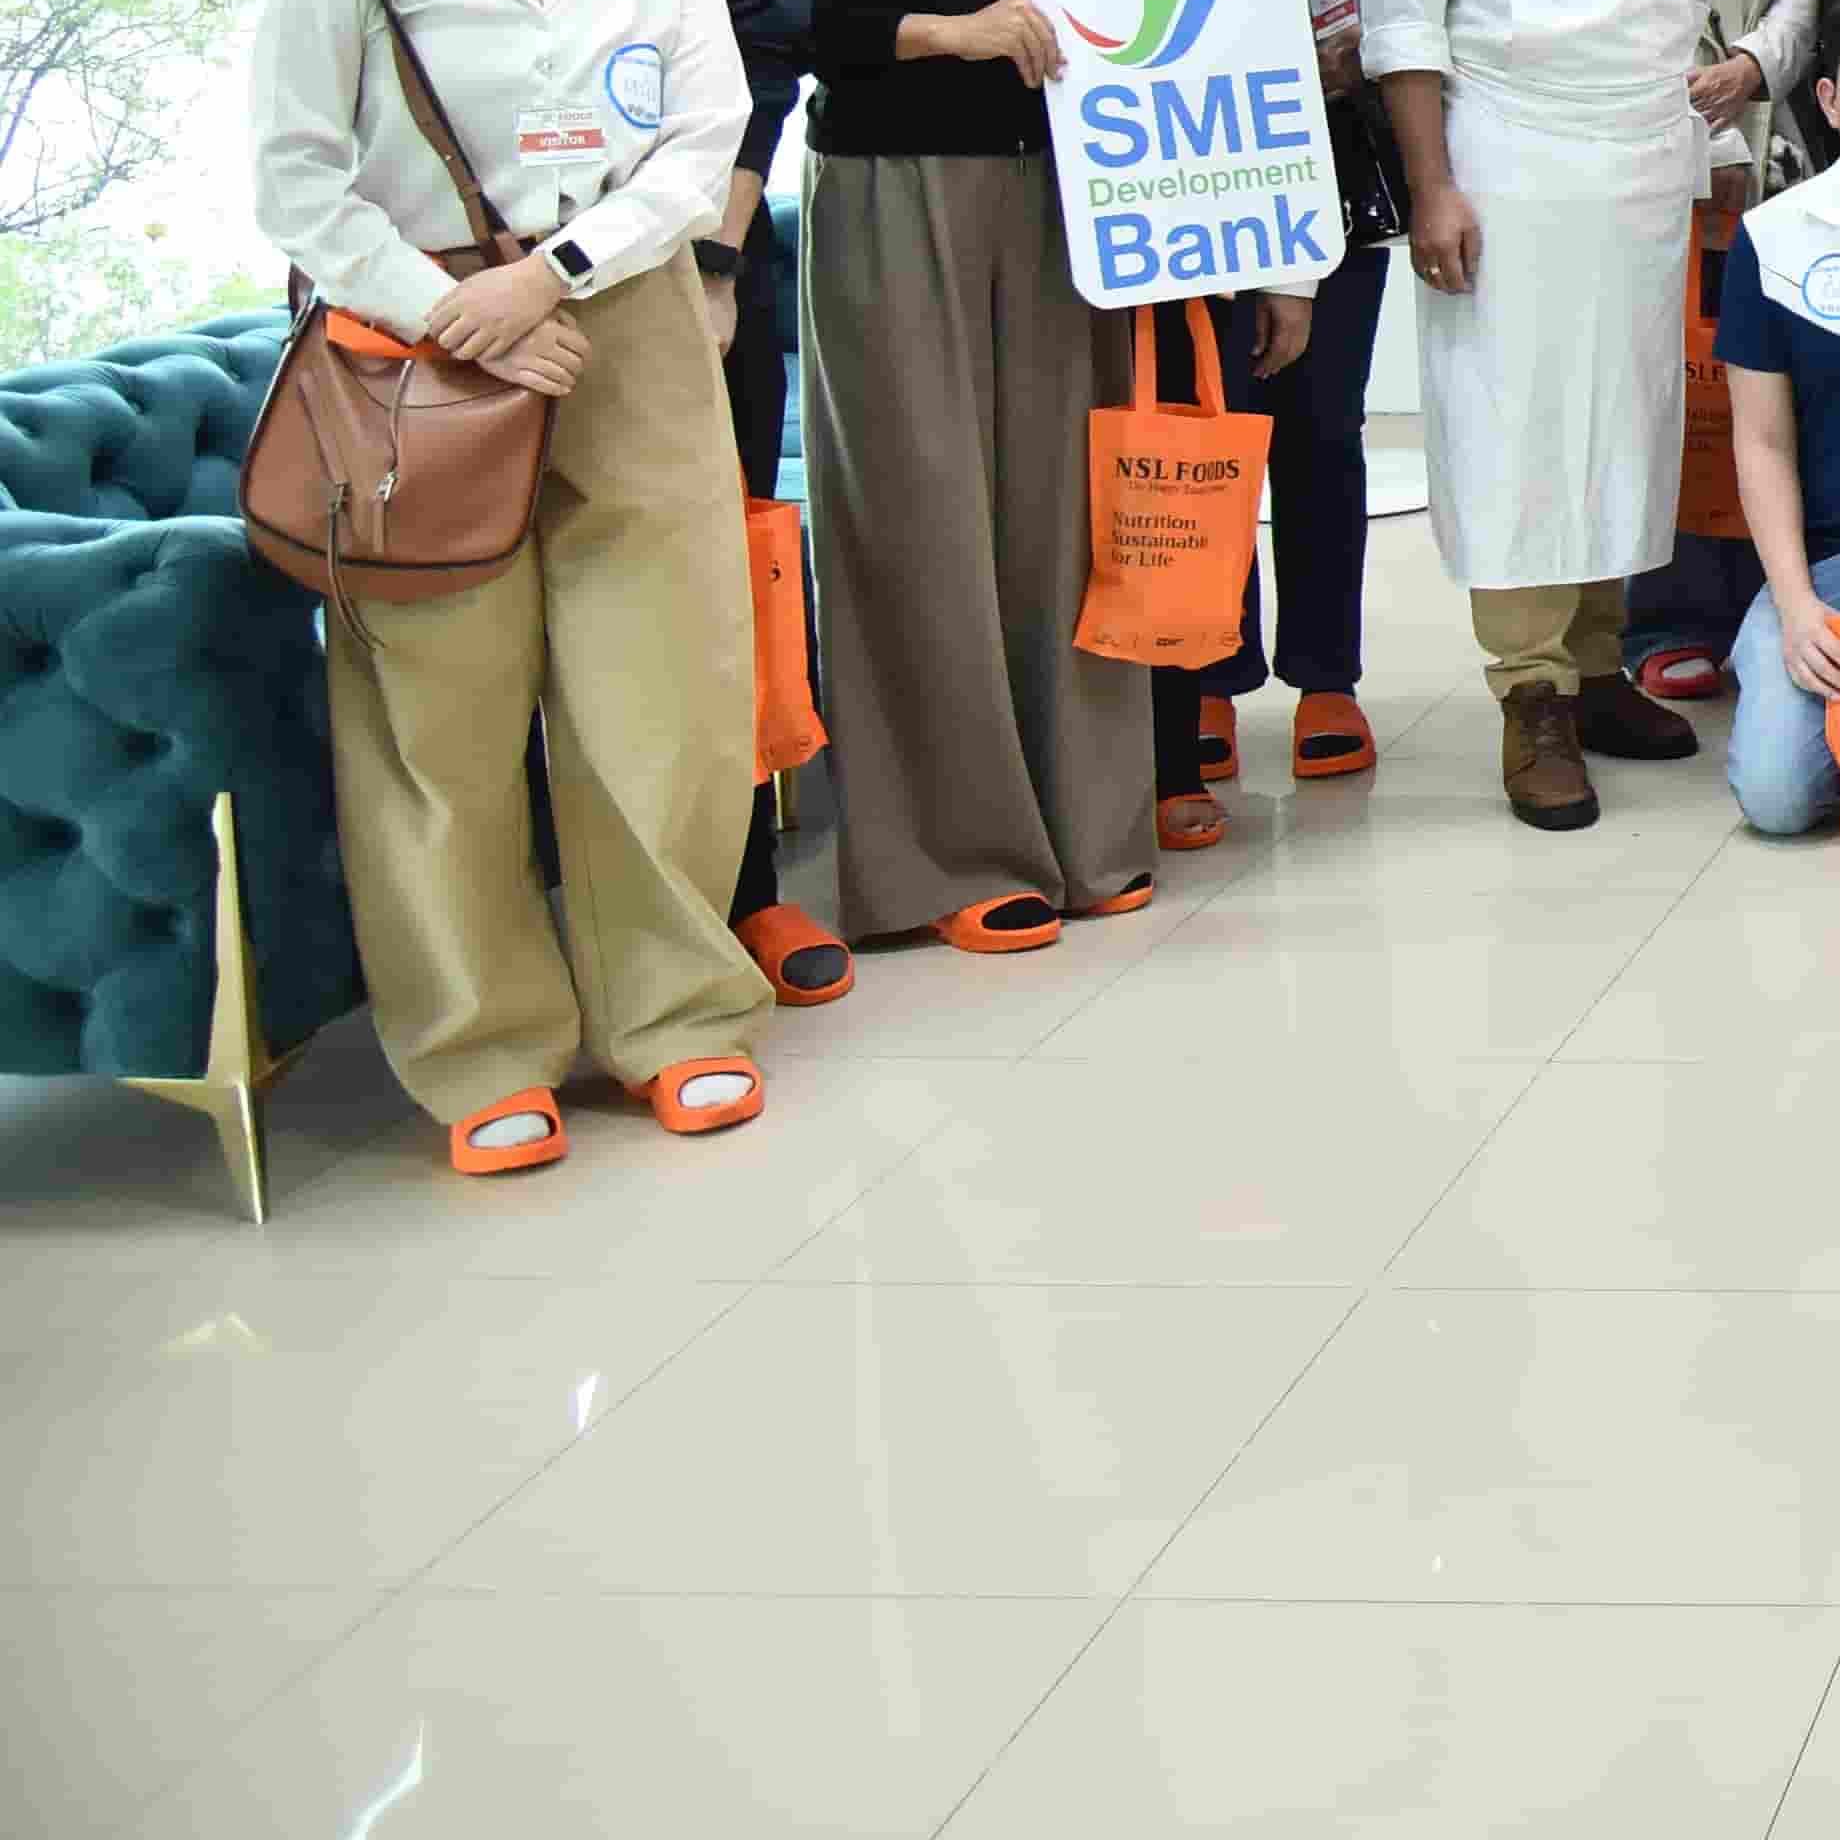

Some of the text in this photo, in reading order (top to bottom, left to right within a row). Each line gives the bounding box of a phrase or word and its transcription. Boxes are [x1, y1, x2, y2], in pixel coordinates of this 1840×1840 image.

[1080, 68, 1311, 169] SME
[1088, 155, 1319, 208] Development
[1094, 194, 1328, 291] Bank
[1115, 457, 1169, 481] NSL
[1112, 510, 1197, 530] Nutrition
